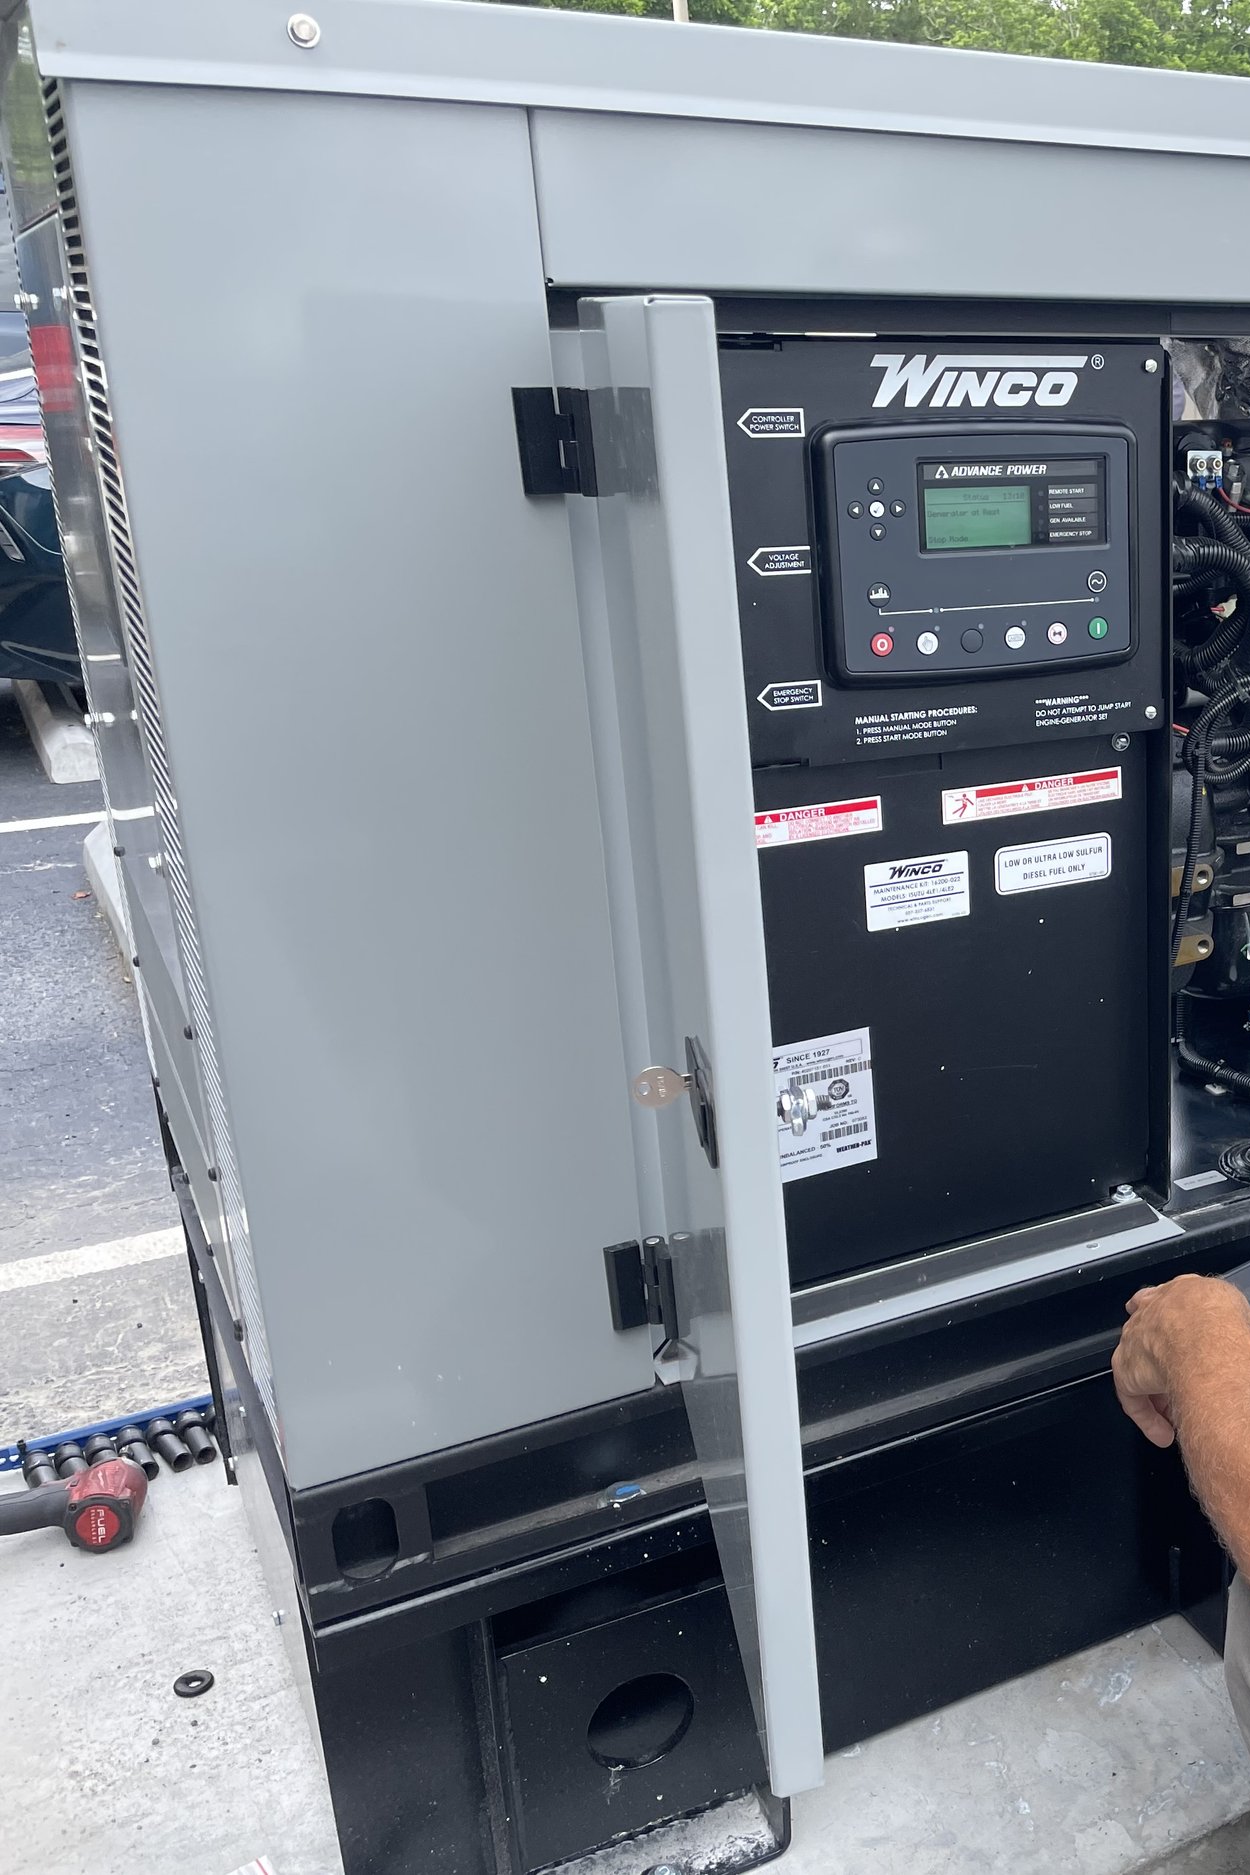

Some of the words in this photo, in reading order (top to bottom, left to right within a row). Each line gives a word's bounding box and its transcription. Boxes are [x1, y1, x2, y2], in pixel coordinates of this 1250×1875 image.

[870, 354, 1088, 408] WINCO
[749, 423, 774, 431] POWER
[775, 423, 800, 431] SWITCH
[951, 465, 1003, 477] ADVANCE
[1006, 464, 1047, 475] POWER
[927, 509, 967, 518] Generator
[928, 536, 946, 545] Stop
[768, 553, 799, 561] VOLTAGE
[764, 560, 805, 569] ADJUSTMENT
[773, 687, 813, 697] EMERGENCY
[790, 695, 814, 703] SWITCH
[855, 714, 889, 725] MANUAL
[890, 710, 927, 722] STARTING
[927, 705, 978, 718] PROCEDURES:
[1047, 708, 1061, 717] NOT
[1061, 706, 1087, 715] ATTEMPT
[1088, 704, 1097, 712] TO
[1097, 703, 1114, 712] JUMP
[1114, 701, 1132, 710] START
[1036, 713, 1098, 727] ENGINE-GENERATOR
[863, 727, 882, 735] PRESS
[882, 724, 911, 733] MANUAL
[911, 721, 933, 729] MODE
[933, 719, 957, 727] BUTTON
[863, 736, 883, 744] PRESS
[883, 734, 902, 742] START
[902, 731, 923, 740] MODE
[923, 729, 948, 738] BUTTON
[1034, 777, 1074, 790] DANGER
[779, 808, 826, 822] DANGER
[1004, 859, 1020, 868] LOW
[1022, 857, 1032, 866] OR
[1034, 853, 1057, 863] ULTRA
[1058, 851, 1075, 860] LOW
[1076, 846, 1103, 857] SULFUR
[889, 859, 946, 880] WINCO
[1023, 870, 1047, 880] DIESEL
[1049, 867, 1066, 876] FUEL
[1067, 863, 1086, 873] ONLY
[873, 882, 918, 895] MAINTENANCE
[880, 894, 906, 903] MODELS:
[888, 904, 913, 912] TECHNICAL
[786, 1052, 811, 1064] SINCE
[813, 1048, 830, 1058] 1927
[96, 1509, 106, 1543] FUEL
